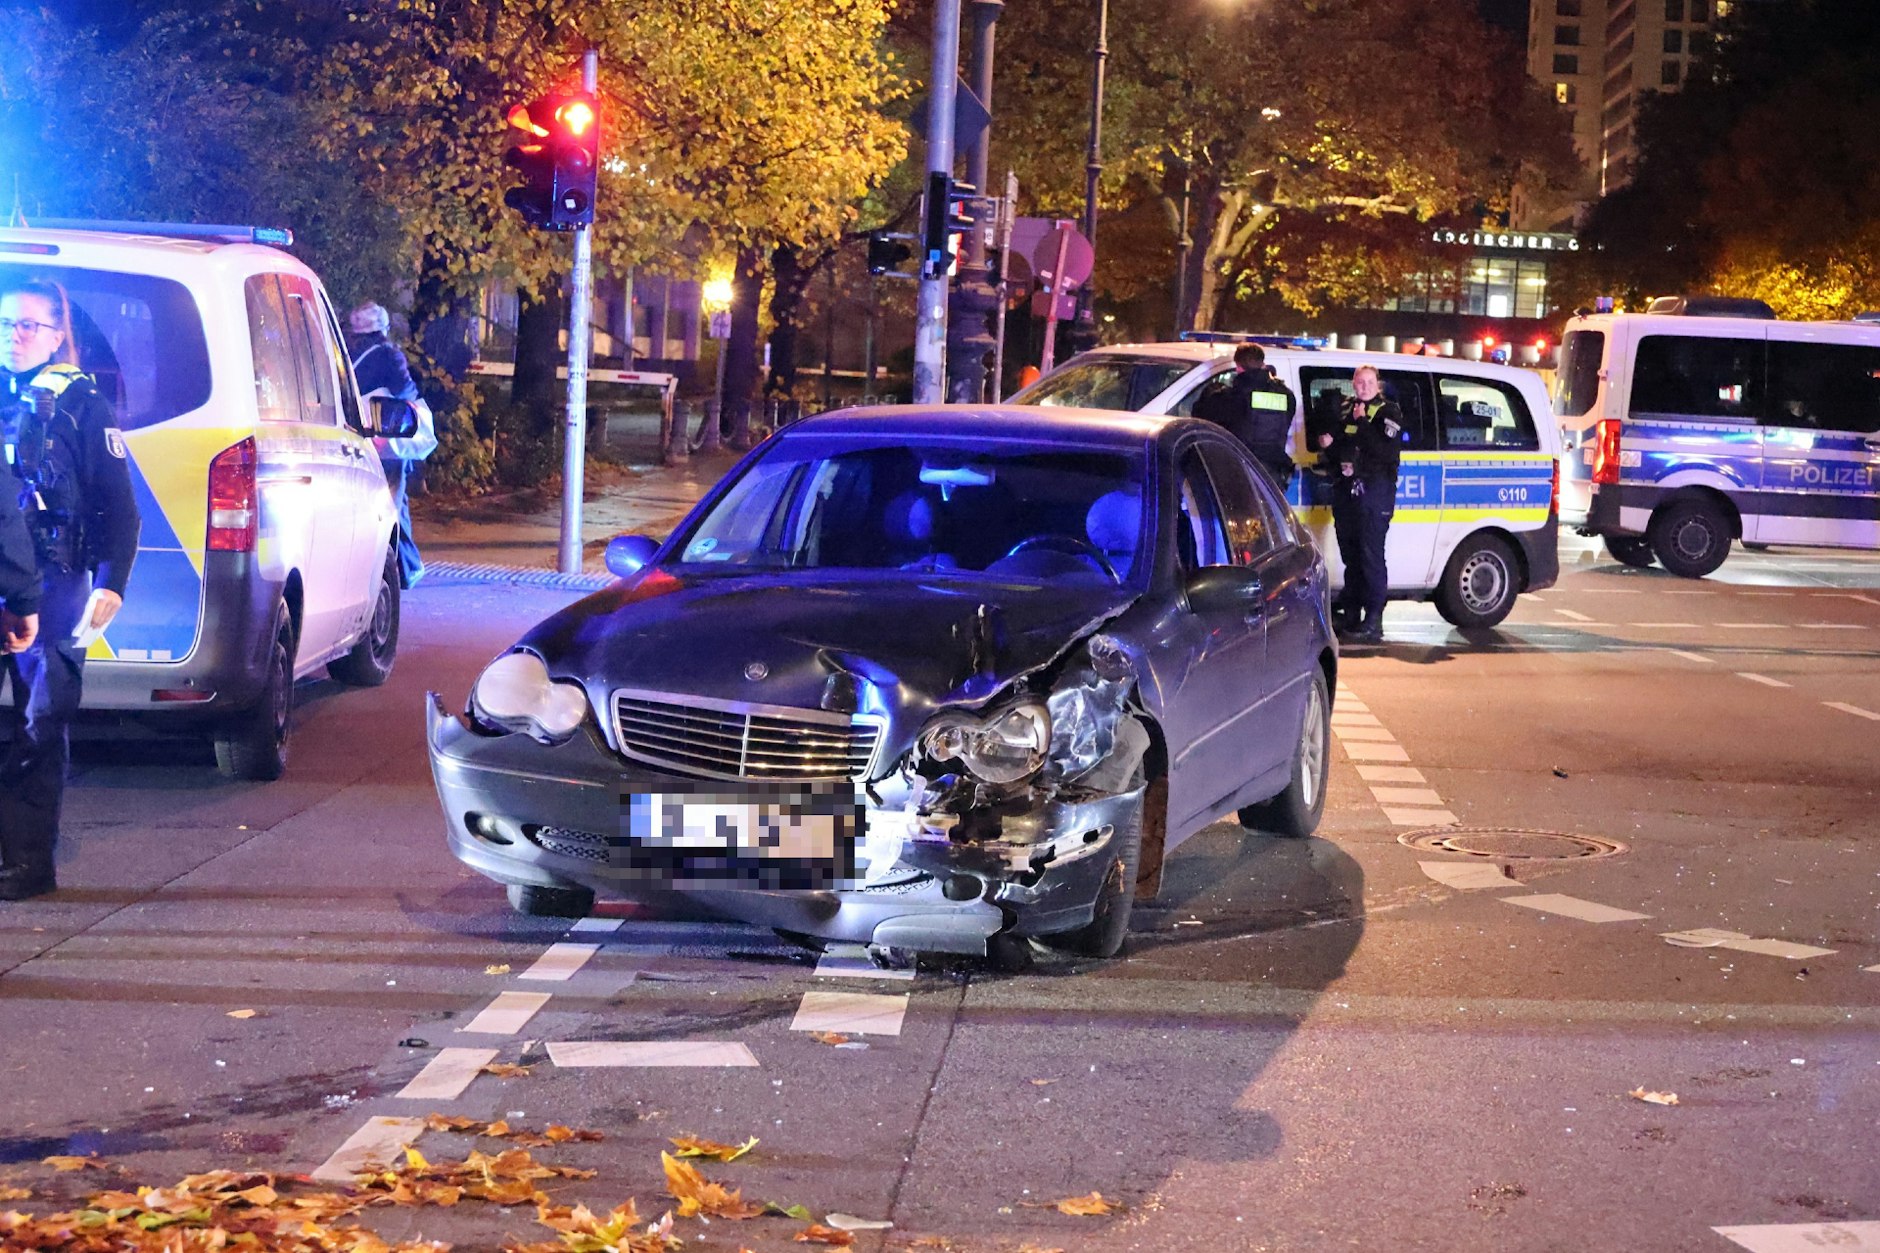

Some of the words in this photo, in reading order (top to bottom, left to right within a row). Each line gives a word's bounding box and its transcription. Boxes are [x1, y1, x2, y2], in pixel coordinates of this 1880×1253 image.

[1432, 231, 1553, 249] LOGISCHER
[1476, 406, 1498, 416] 25-01
[1790, 466, 1873, 486] POLIZEI
[1395, 475, 1425, 498] ZEI
[1508, 488, 1527, 501] 110
